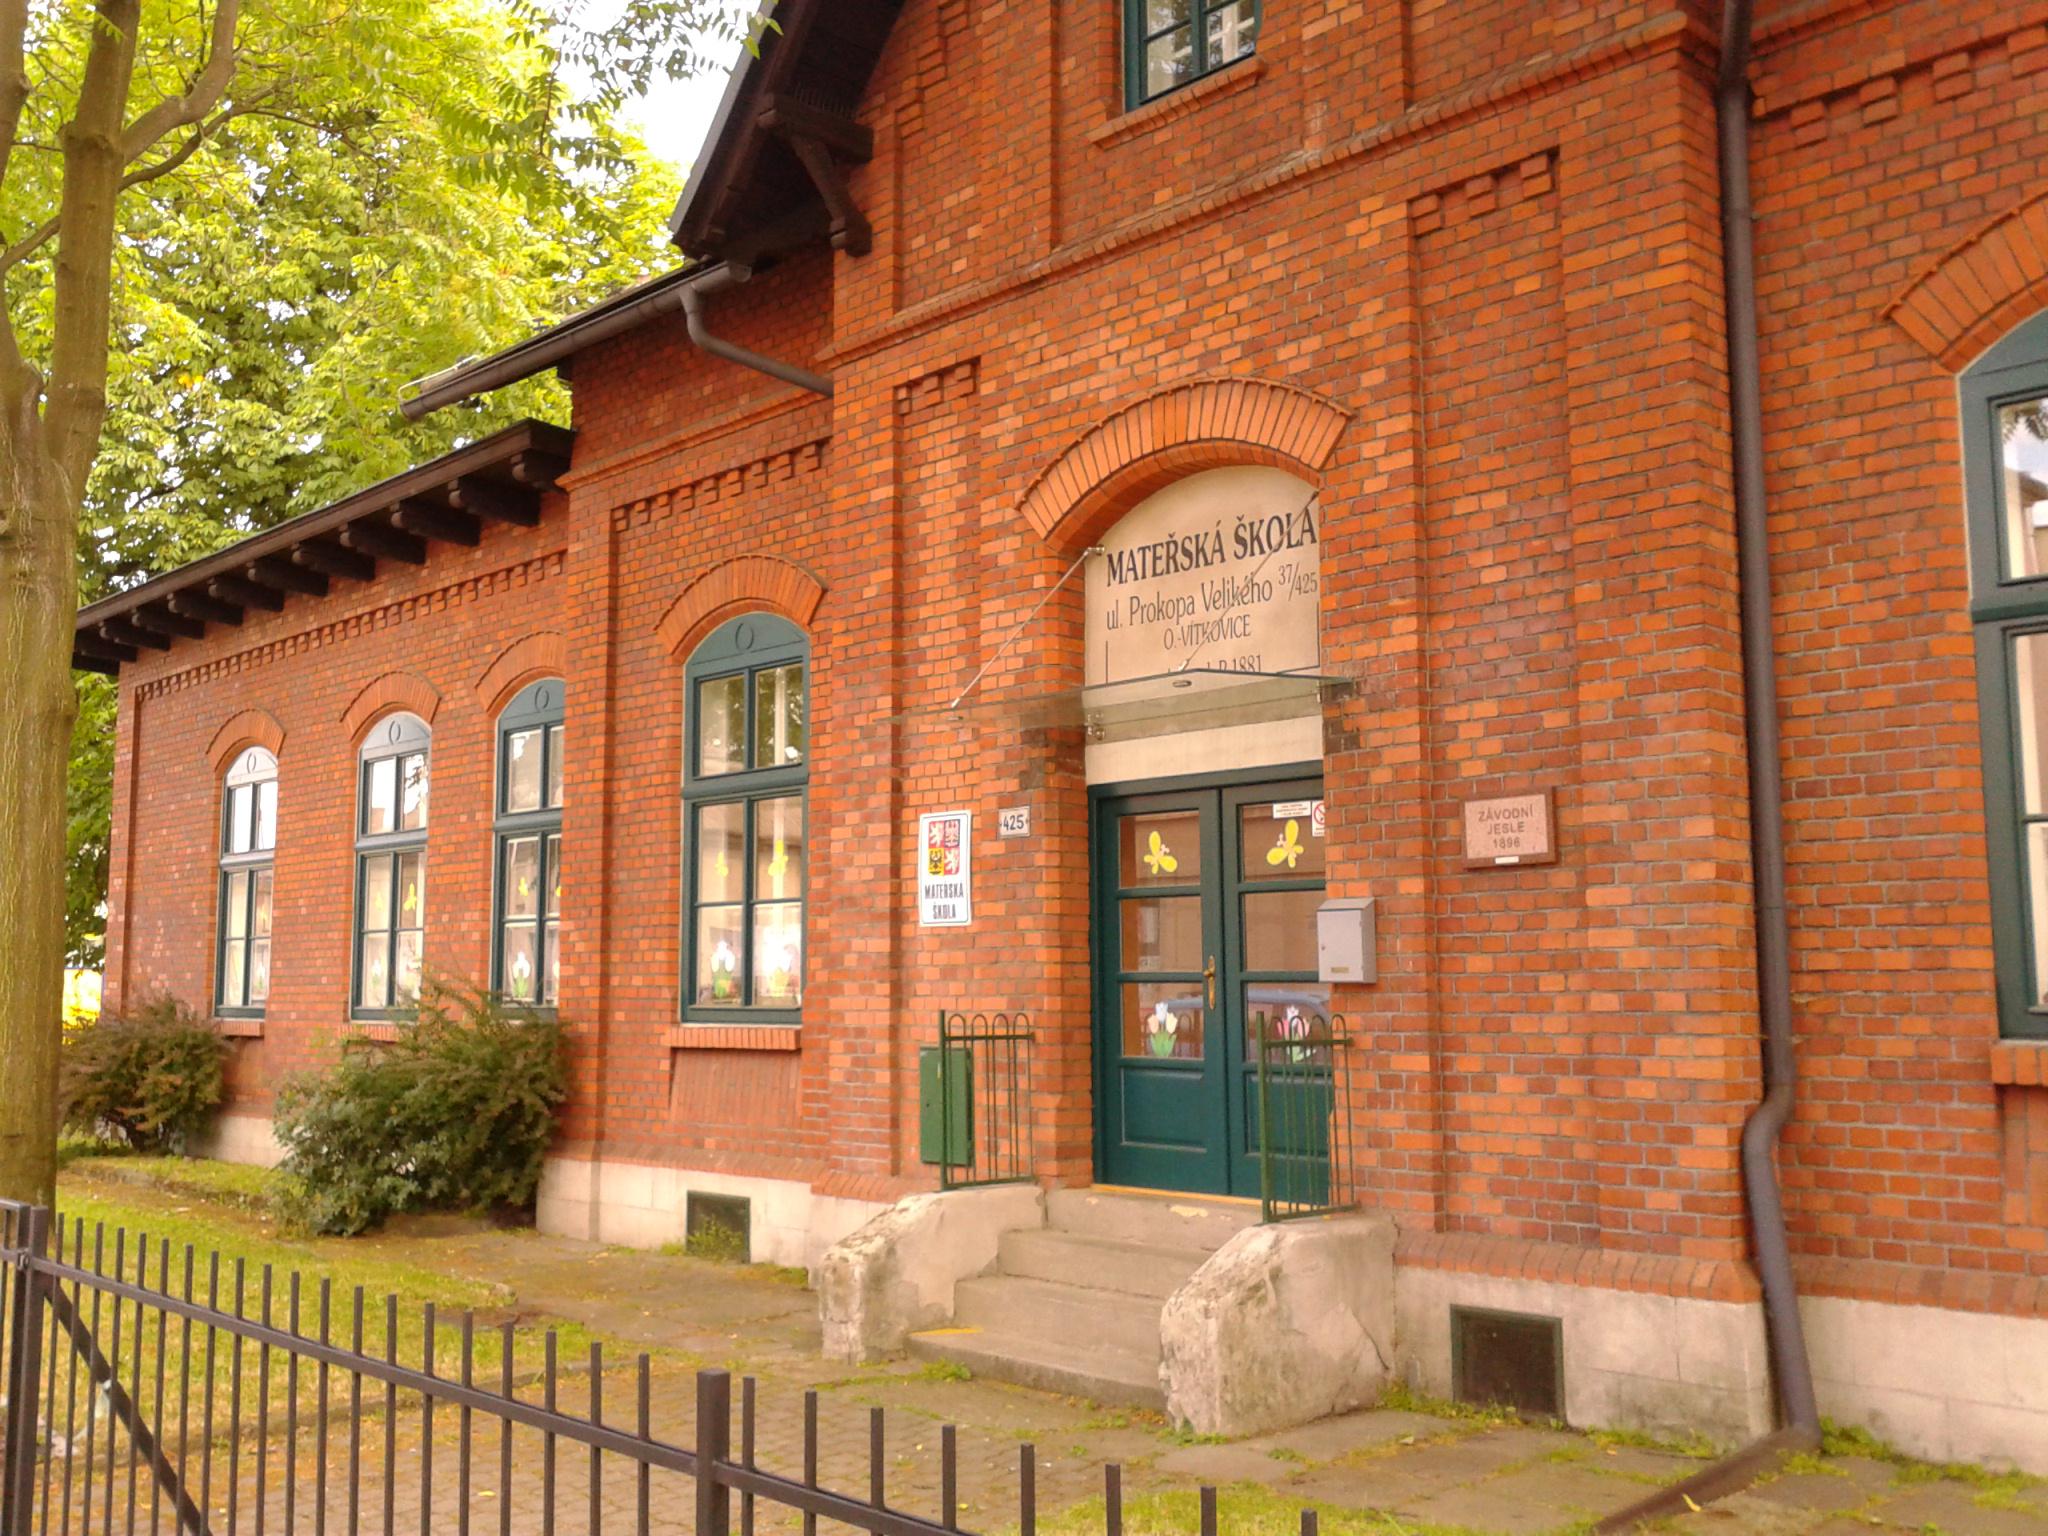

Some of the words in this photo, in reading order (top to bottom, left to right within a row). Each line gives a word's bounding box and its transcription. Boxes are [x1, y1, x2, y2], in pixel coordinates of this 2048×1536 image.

[1106, 520, 1226, 588] MATEŘSKÁ
[1233, 506, 1318, 560] ŠKOLA
[1106, 599, 1123, 631] ul.
[1129, 591, 1196, 626] Prokopa
[1201, 575, 1273, 613] Velikého
[1478, 804, 1534, 822] ZÁVODNÍ
[1002, 814, 1024, 831] 425
[1487, 821, 1526, 835] JESLE
